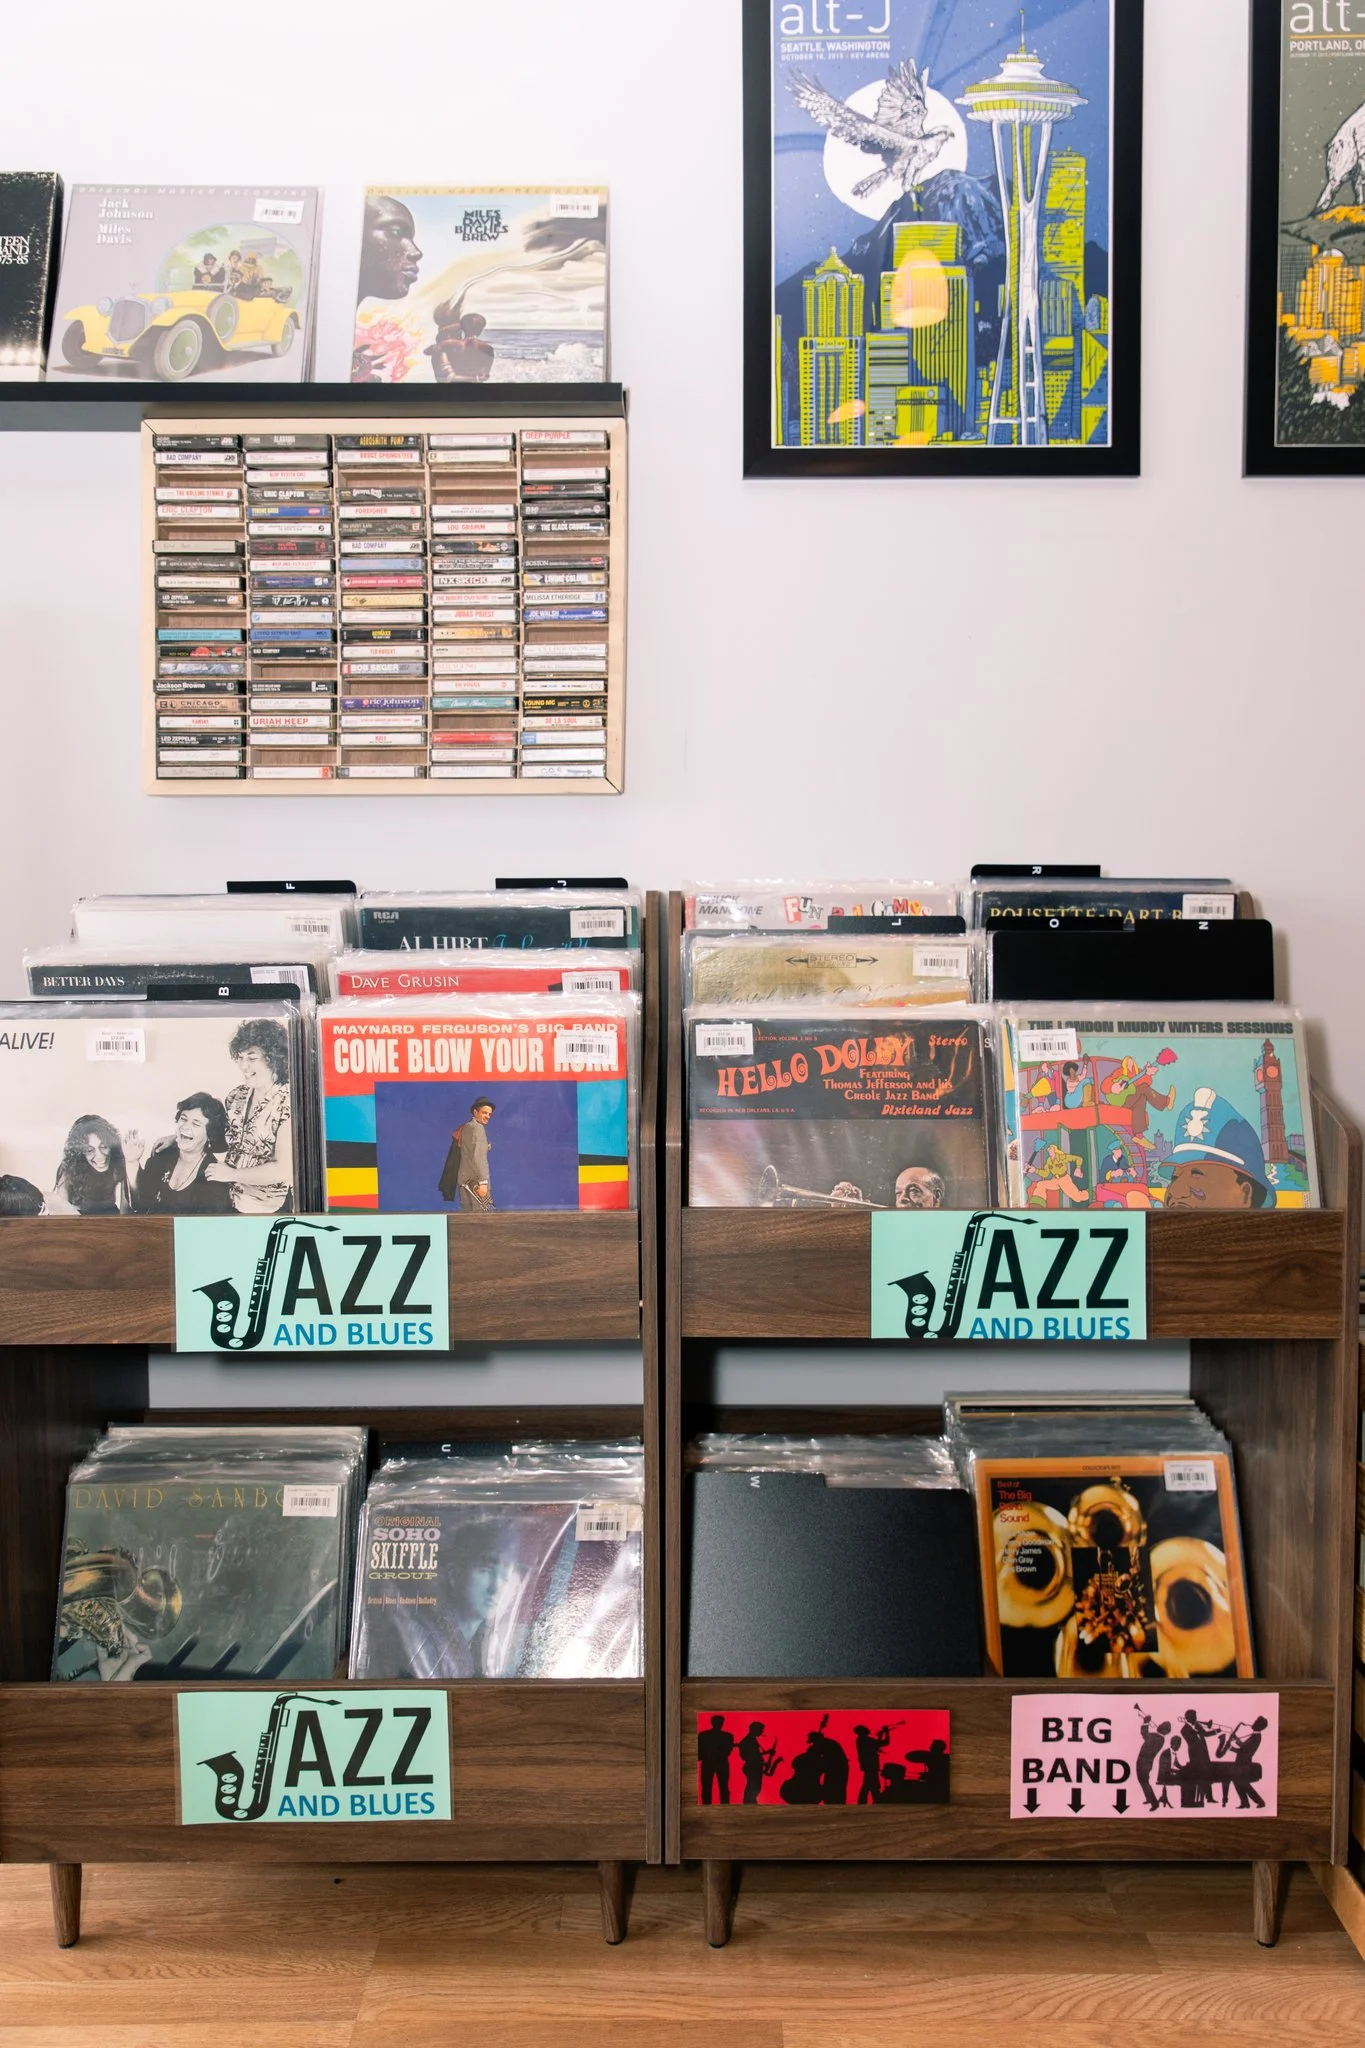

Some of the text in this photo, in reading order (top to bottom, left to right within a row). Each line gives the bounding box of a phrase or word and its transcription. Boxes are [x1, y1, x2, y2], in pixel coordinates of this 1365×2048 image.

[780, 0, 891, 34] alt-J
[781, 41, 891, 53] SEATTLE, WASHINGTON
[1289, 40, 1353, 51] PORTLAND,
[98, 198, 129, 209] Jack
[97, 208, 154, 219] Johnson
[464, 209, 501, 218] MILES
[462, 217, 502, 226] DAVIS
[97, 223, 132, 234] Miles
[454, 225, 509, 234] BITCHES
[96, 234, 133, 245] Davis
[462, 233, 500, 242] BREW
[359, 436, 405, 446] AEROSMITH PUMP
[525, 432, 571, 440] DEEP PURPLE
[263, 490, 305, 498] ERIC CLAPTON
[162, 506, 213, 514] ERIC CLAPTON
[350, 663, 399, 672] BOB SEGER
[156, 682, 182, 690] Jackson
[182, 682, 206, 690] Browne
[362, 697, 420, 706] eric johnson
[252, 717, 309, 725] URIAH HEEP
[1031, 865, 1042, 875] R
[372, 911, 400, 919] RCA
[698, 905, 764, 915] MANONE
[783, 896, 823, 924] FUN
[1049, 918, 1060, 928] O
[43, 976, 125, 987] BETTER DAYS
[218, 986, 229, 996] B
[333, 1023, 619, 1035] MAYNARD FERGUSON'S BIG BAND
[1027, 1020, 1053, 1030] THE
[1117, 1021, 1166, 1033] MUDDY
[1168, 1021, 1223, 1033] WATERS
[1226, 1022, 1294, 1034] SESSIONS
[0, 1032, 55, 1050] ALIVE!
[928, 1033, 969, 1047] Stereo
[333, 1038, 544, 1073] COME BLOW YOUR
[716, 1035, 915, 1098] HELLO DOLLY
[881, 1104, 974, 1116] Dixieland Jazz
[273, 1321, 434, 1346] AND BLUES
[969, 1316, 1131, 1340] AND BLUES
[750, 1475, 761, 1489] W
[74, 1487, 165, 1509] DAVID
[998, 1490, 1033, 1501] The Big
[374, 1516, 442, 1527] ORIGINAL
[1000, 1513, 1030, 1523] Sound
[372, 1527, 441, 1541] SOHO
[370, 1541, 439, 1570] SKIFFLE
[1018, 1556, 1034, 1565] Gray
[368, 1572, 438, 1580] GROUP
[1041, 1717, 1112, 1744] BIG
[1021, 1757, 1131, 1785] BAND
[277, 1792, 436, 1816] AND BLUES
